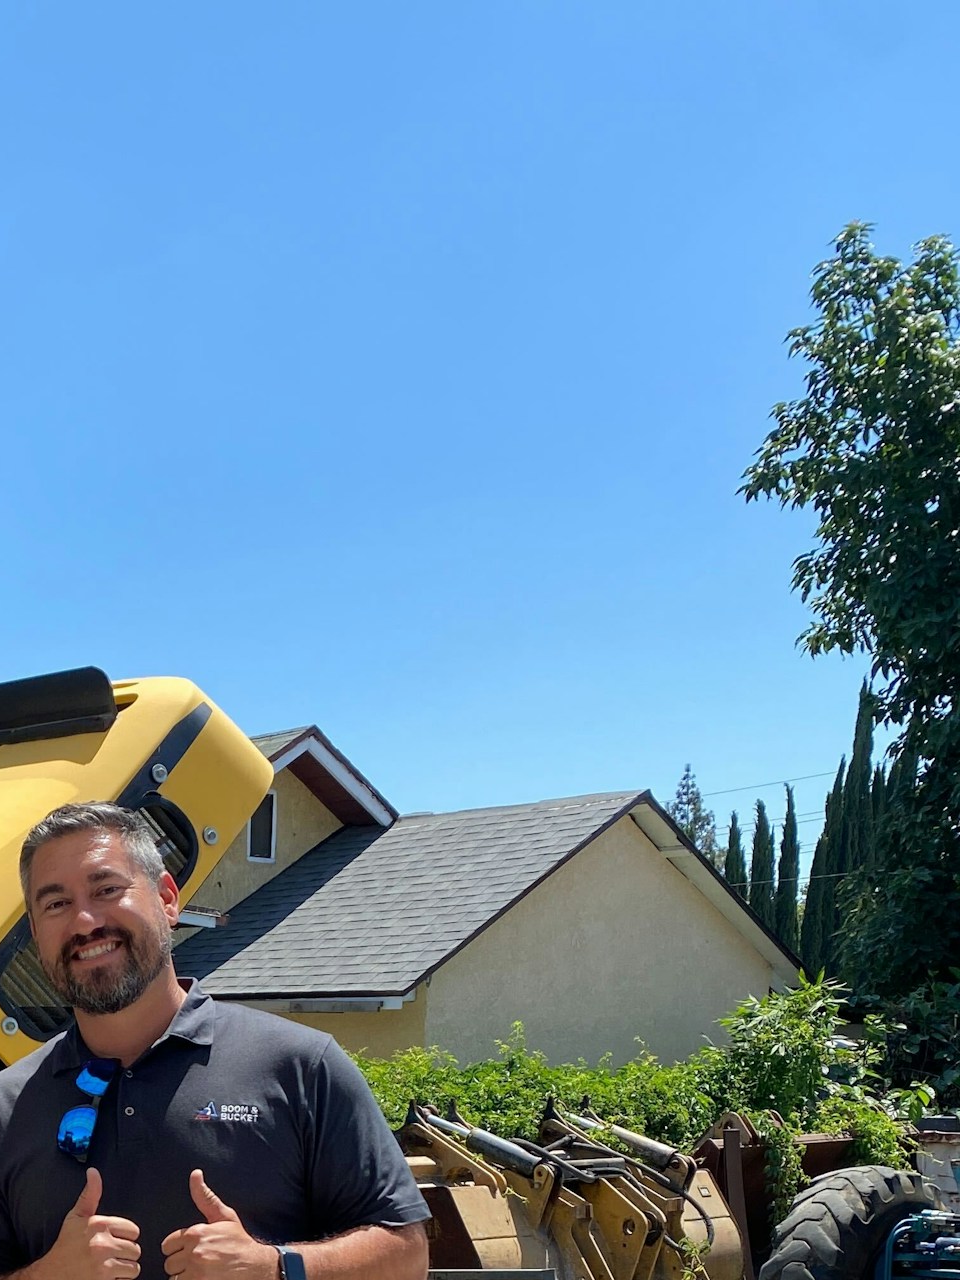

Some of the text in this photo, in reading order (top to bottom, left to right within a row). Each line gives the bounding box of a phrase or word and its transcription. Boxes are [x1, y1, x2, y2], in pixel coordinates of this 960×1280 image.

[221, 1105, 258, 1114] BOOM &
[220, 1113, 259, 1122] BUCKET
